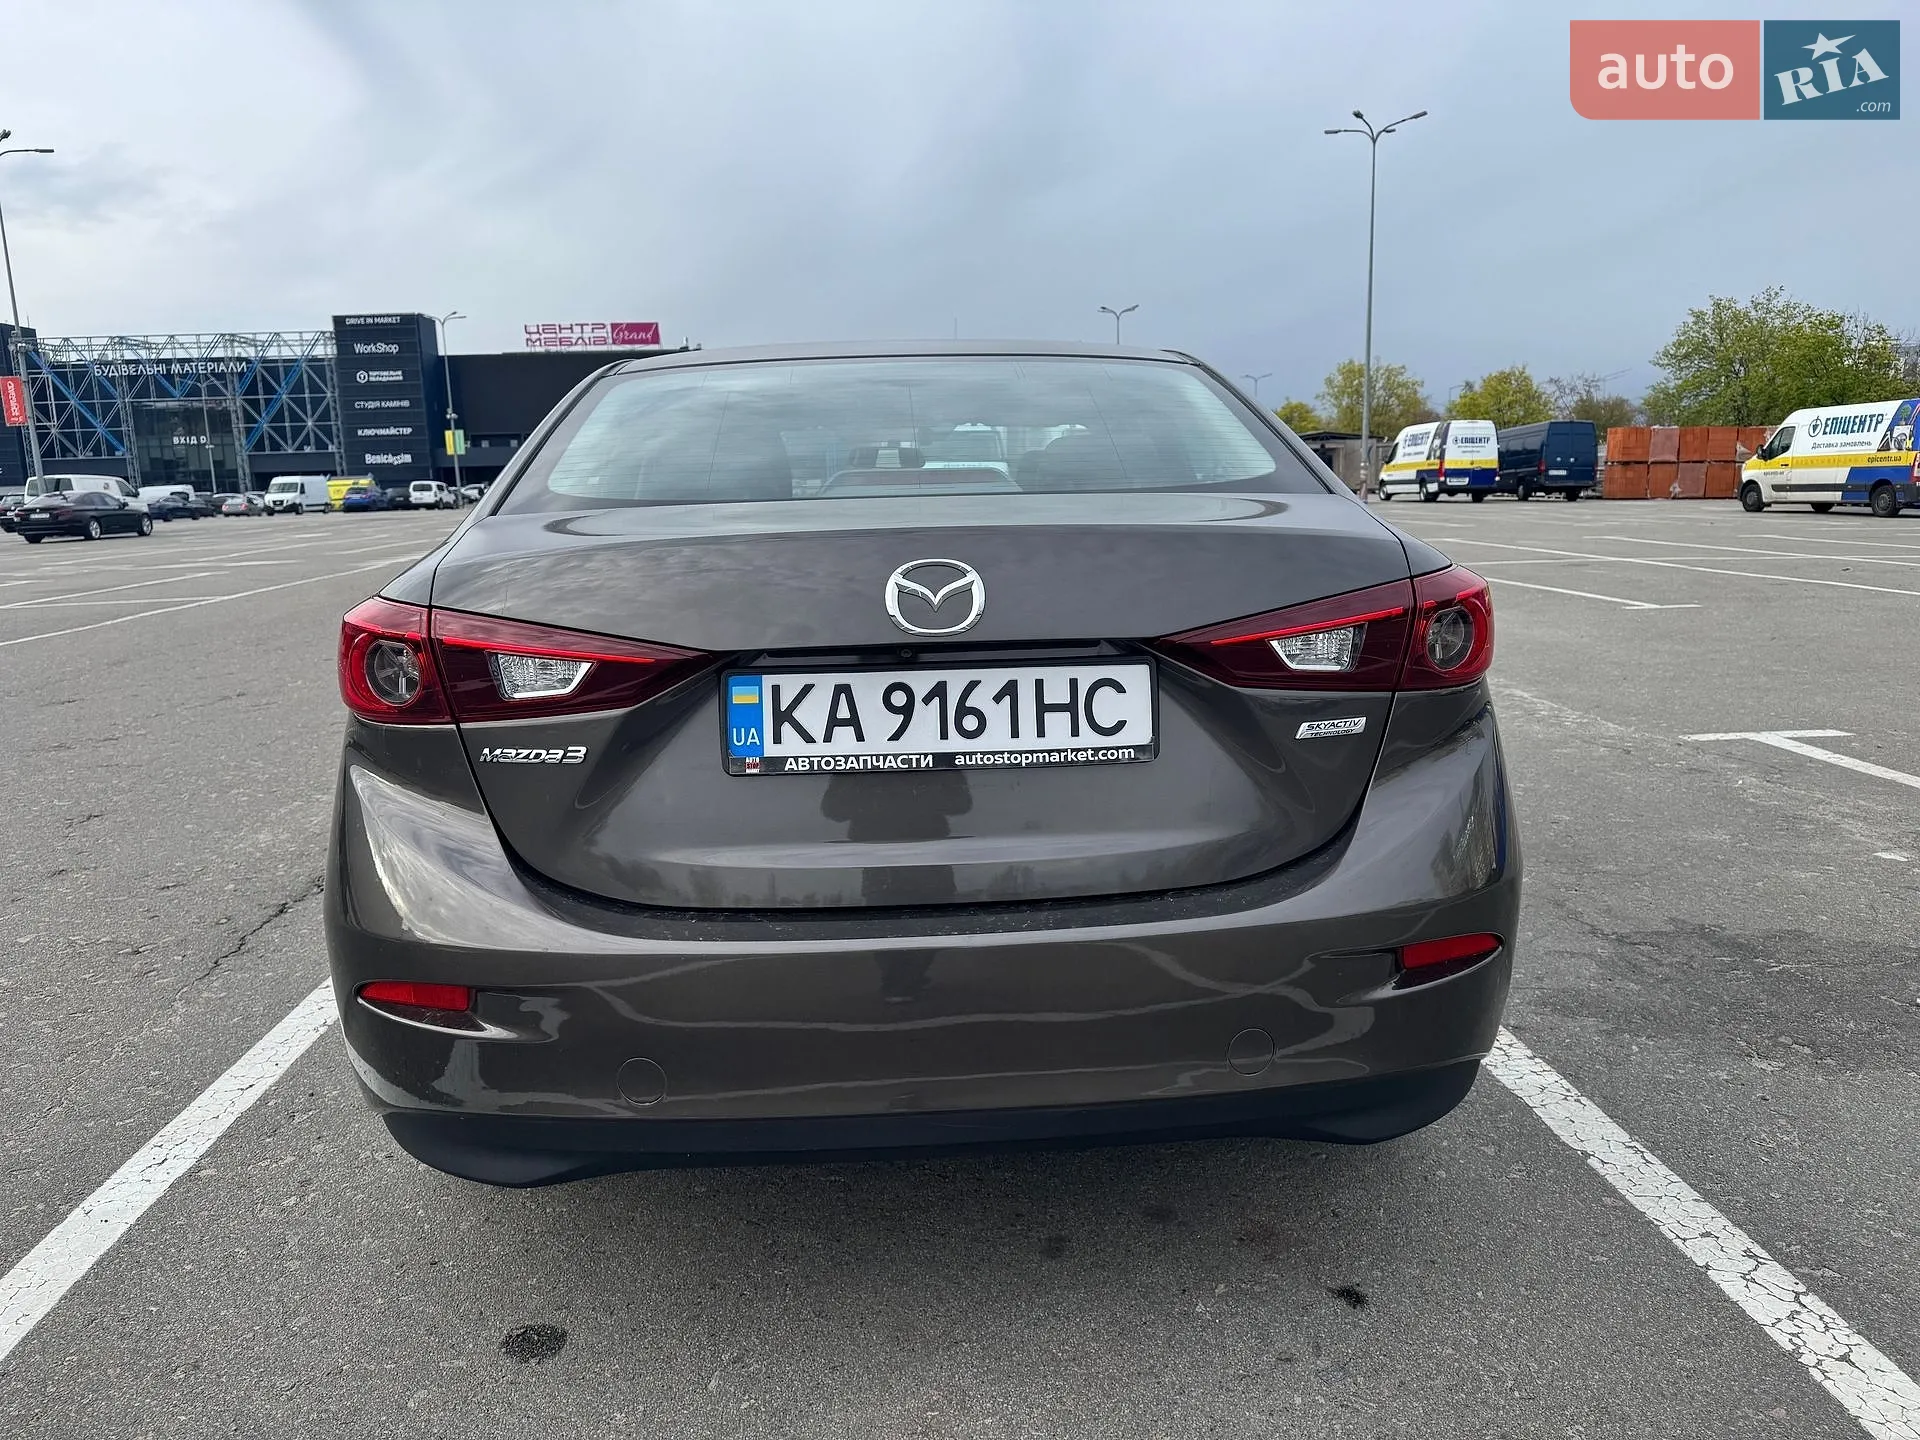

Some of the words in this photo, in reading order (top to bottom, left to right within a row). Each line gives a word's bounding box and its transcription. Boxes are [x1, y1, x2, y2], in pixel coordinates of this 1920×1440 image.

[345, 317, 365, 325] DRIVE
[374, 316, 400, 324] MARKET
[524, 323, 607, 335] ЦЕНТР
[613, 323, 657, 344] Grand
[525, 336, 608, 347] МЕБЛІВ
[353, 342, 400, 355] WorkShop
[93, 363, 167, 378] БУДІВЕЛЬНІ
[170, 361, 248, 375] МАТЕРІАЛИ
[1822, 413, 1885, 436] ЕПІЦЕНТР
[173, 436, 198, 445] ВХІД
[1867, 455, 1902, 464] epicentr.ua
[1306, 719, 1361, 731] SKYACTIV
[733, 728, 760, 746] UA
[1310, 728, 1355, 737] TECHNOLOGY
[784, 754, 933, 771] АВТОЗАПЧАСТИ
[955, 746, 1135, 767] autostopmarket.com
